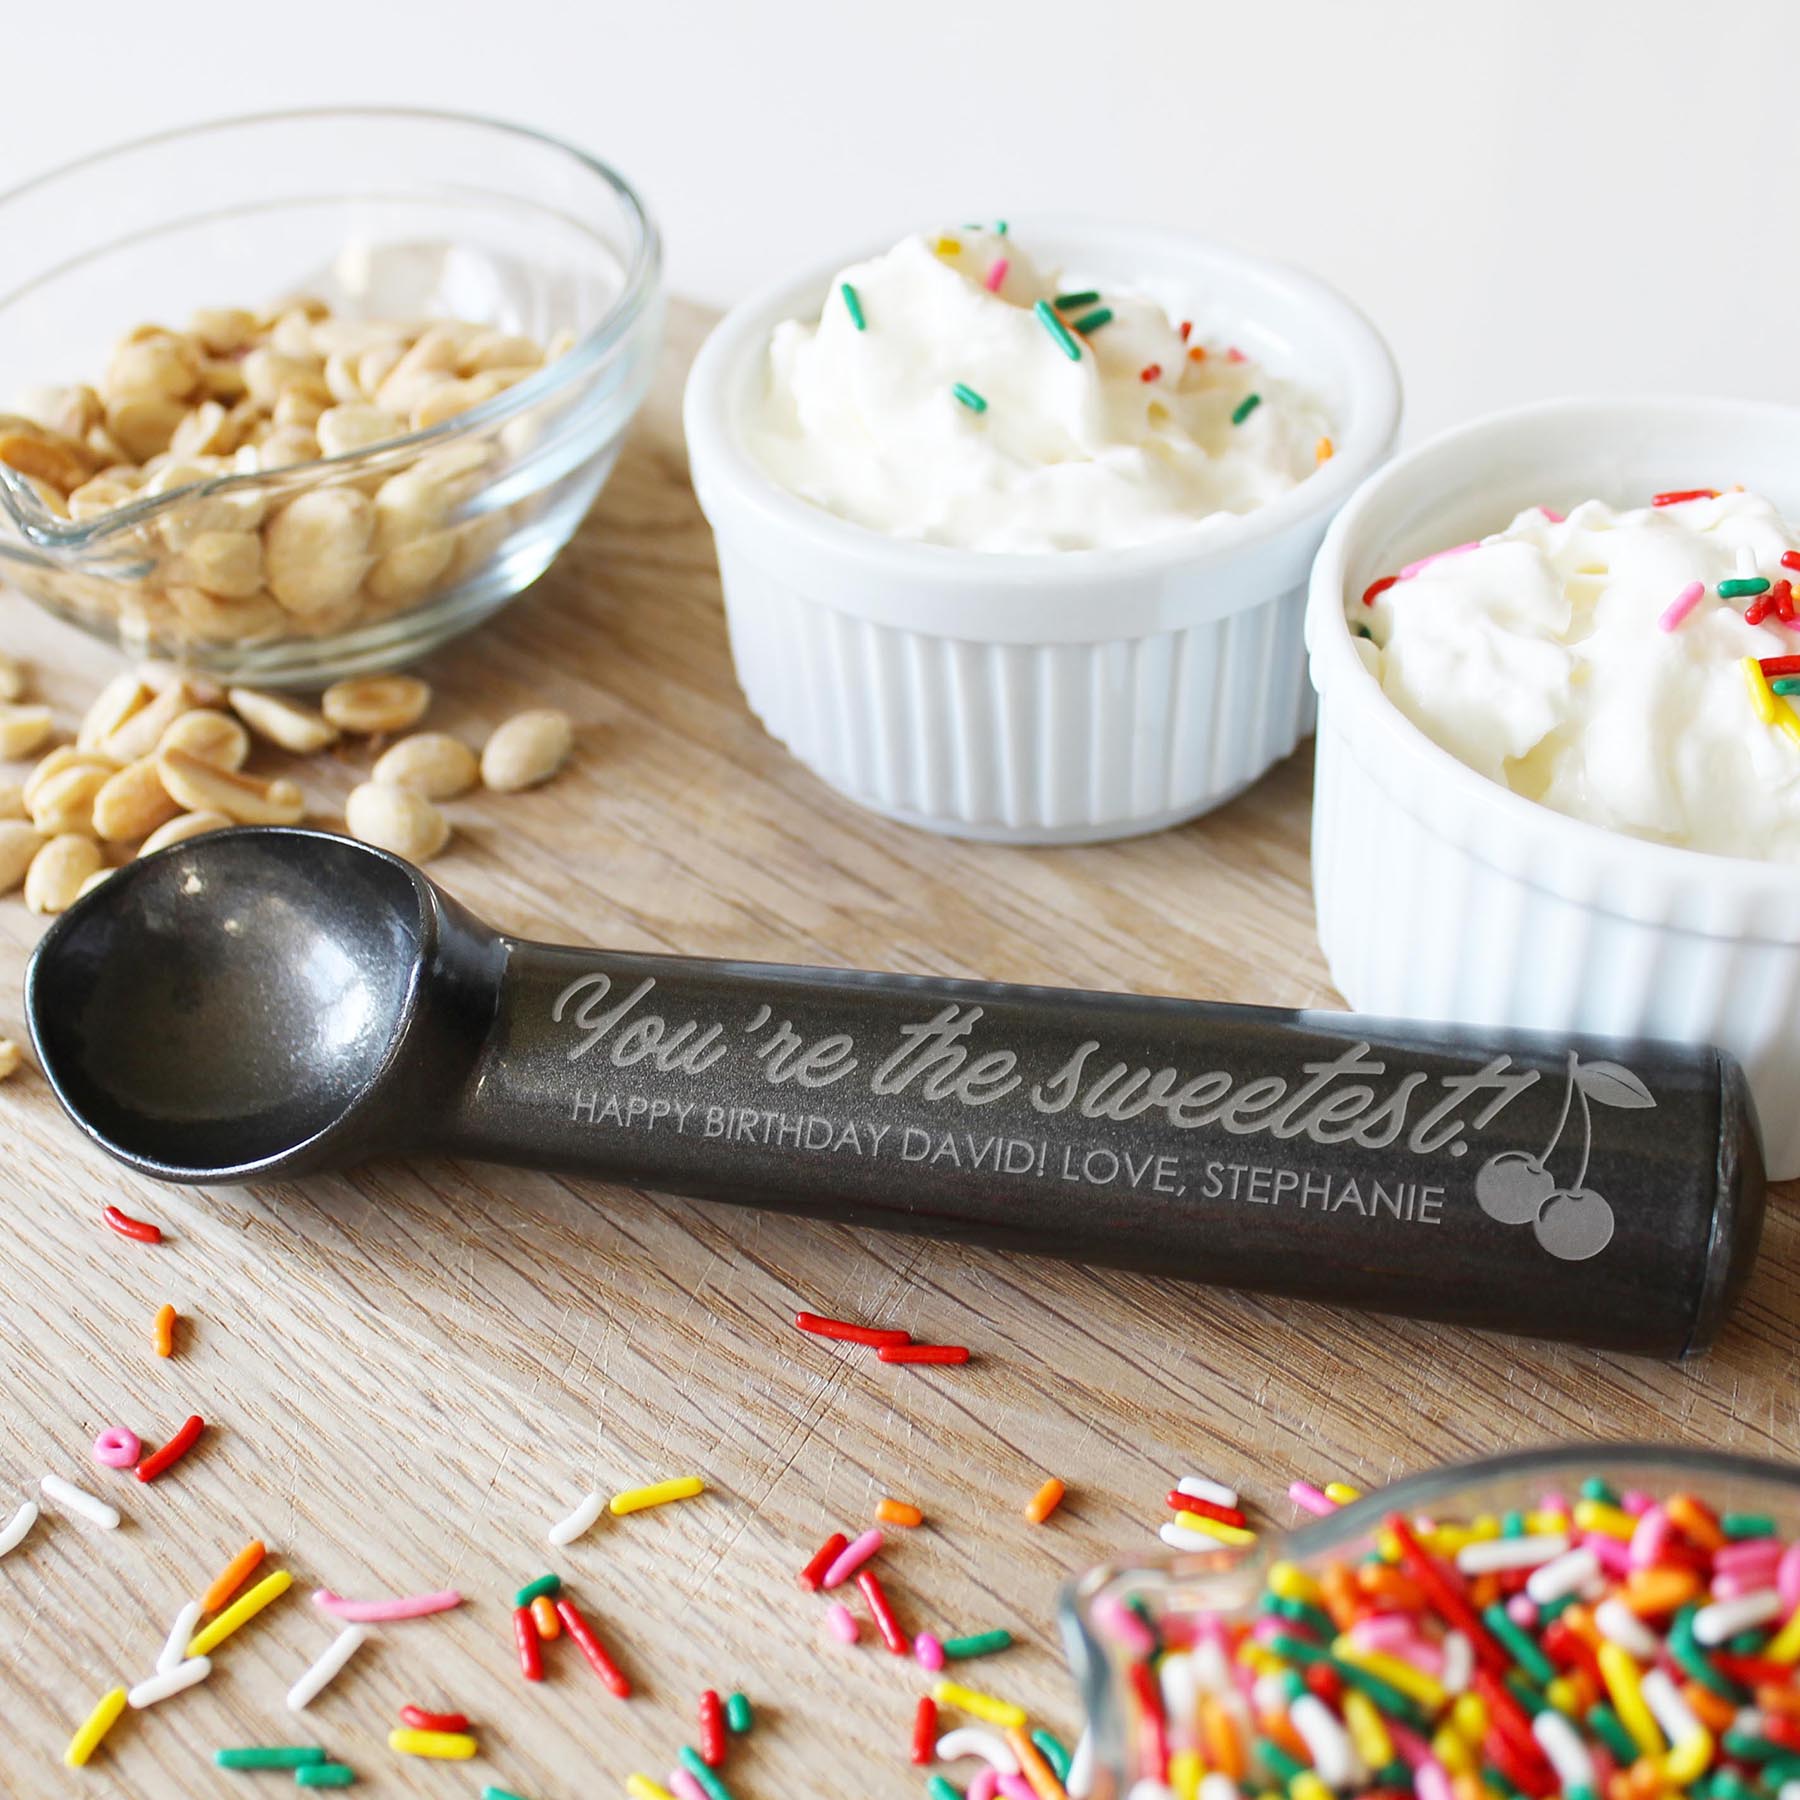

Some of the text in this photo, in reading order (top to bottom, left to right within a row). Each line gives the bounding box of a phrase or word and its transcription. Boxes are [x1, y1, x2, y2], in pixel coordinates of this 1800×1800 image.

[552, 973, 1541, 1157] You're the sweetest!
[573, 1090, 1445, 1225] HAPPY BIRTHDAY DAVID! LOVE, STEPHANIE
